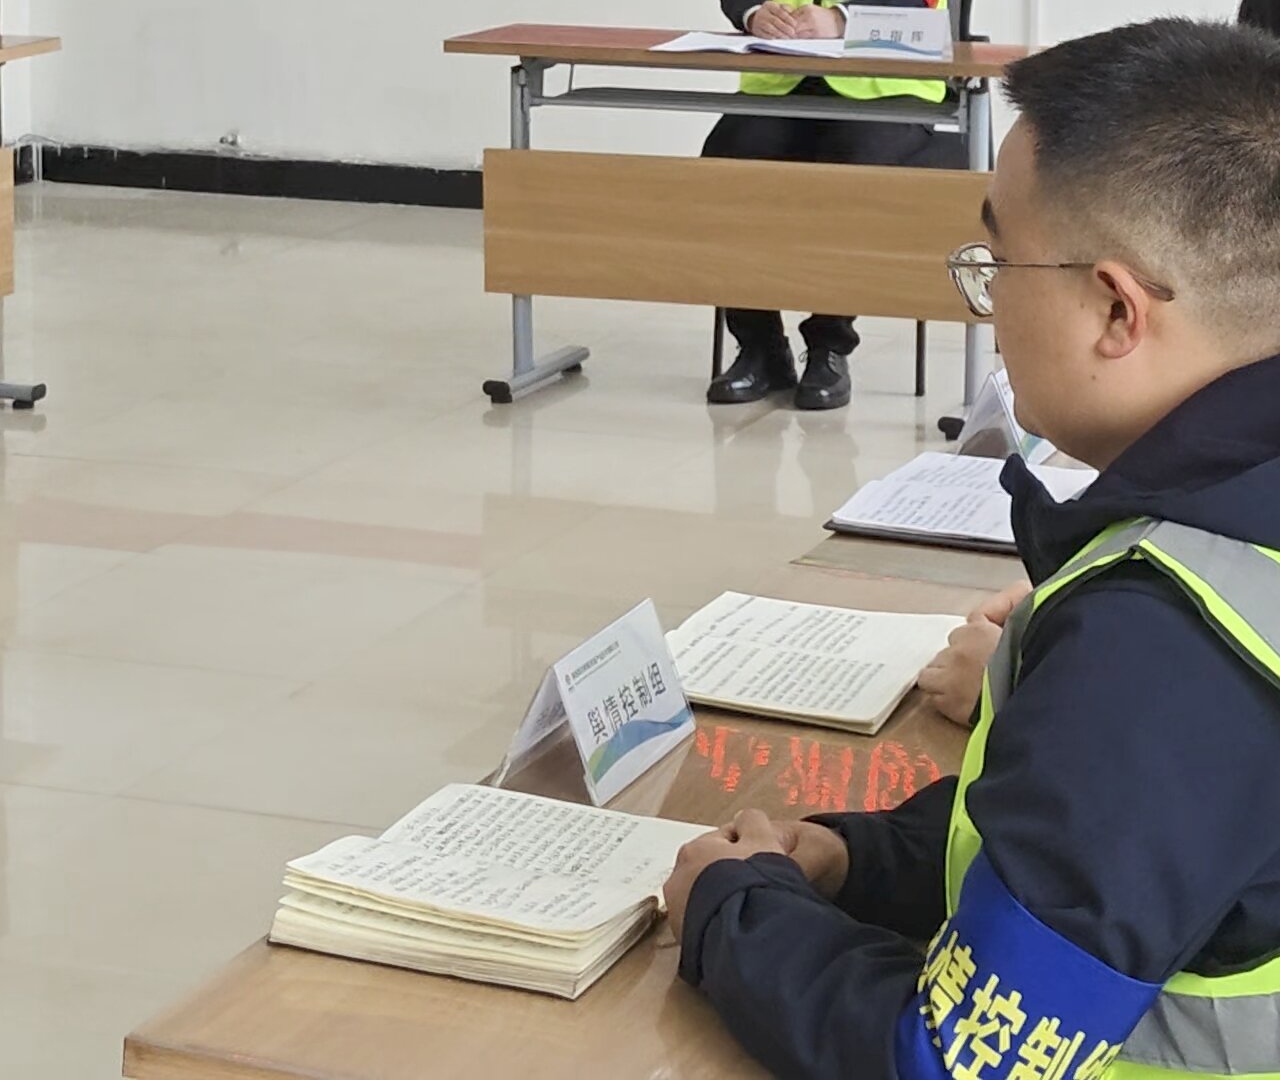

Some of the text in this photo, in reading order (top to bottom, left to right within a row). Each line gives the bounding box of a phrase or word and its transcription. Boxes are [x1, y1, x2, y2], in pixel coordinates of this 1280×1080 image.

[587, 662, 667, 744] 舆情控制组
[918, 920, 1123, 1080] 情控制
